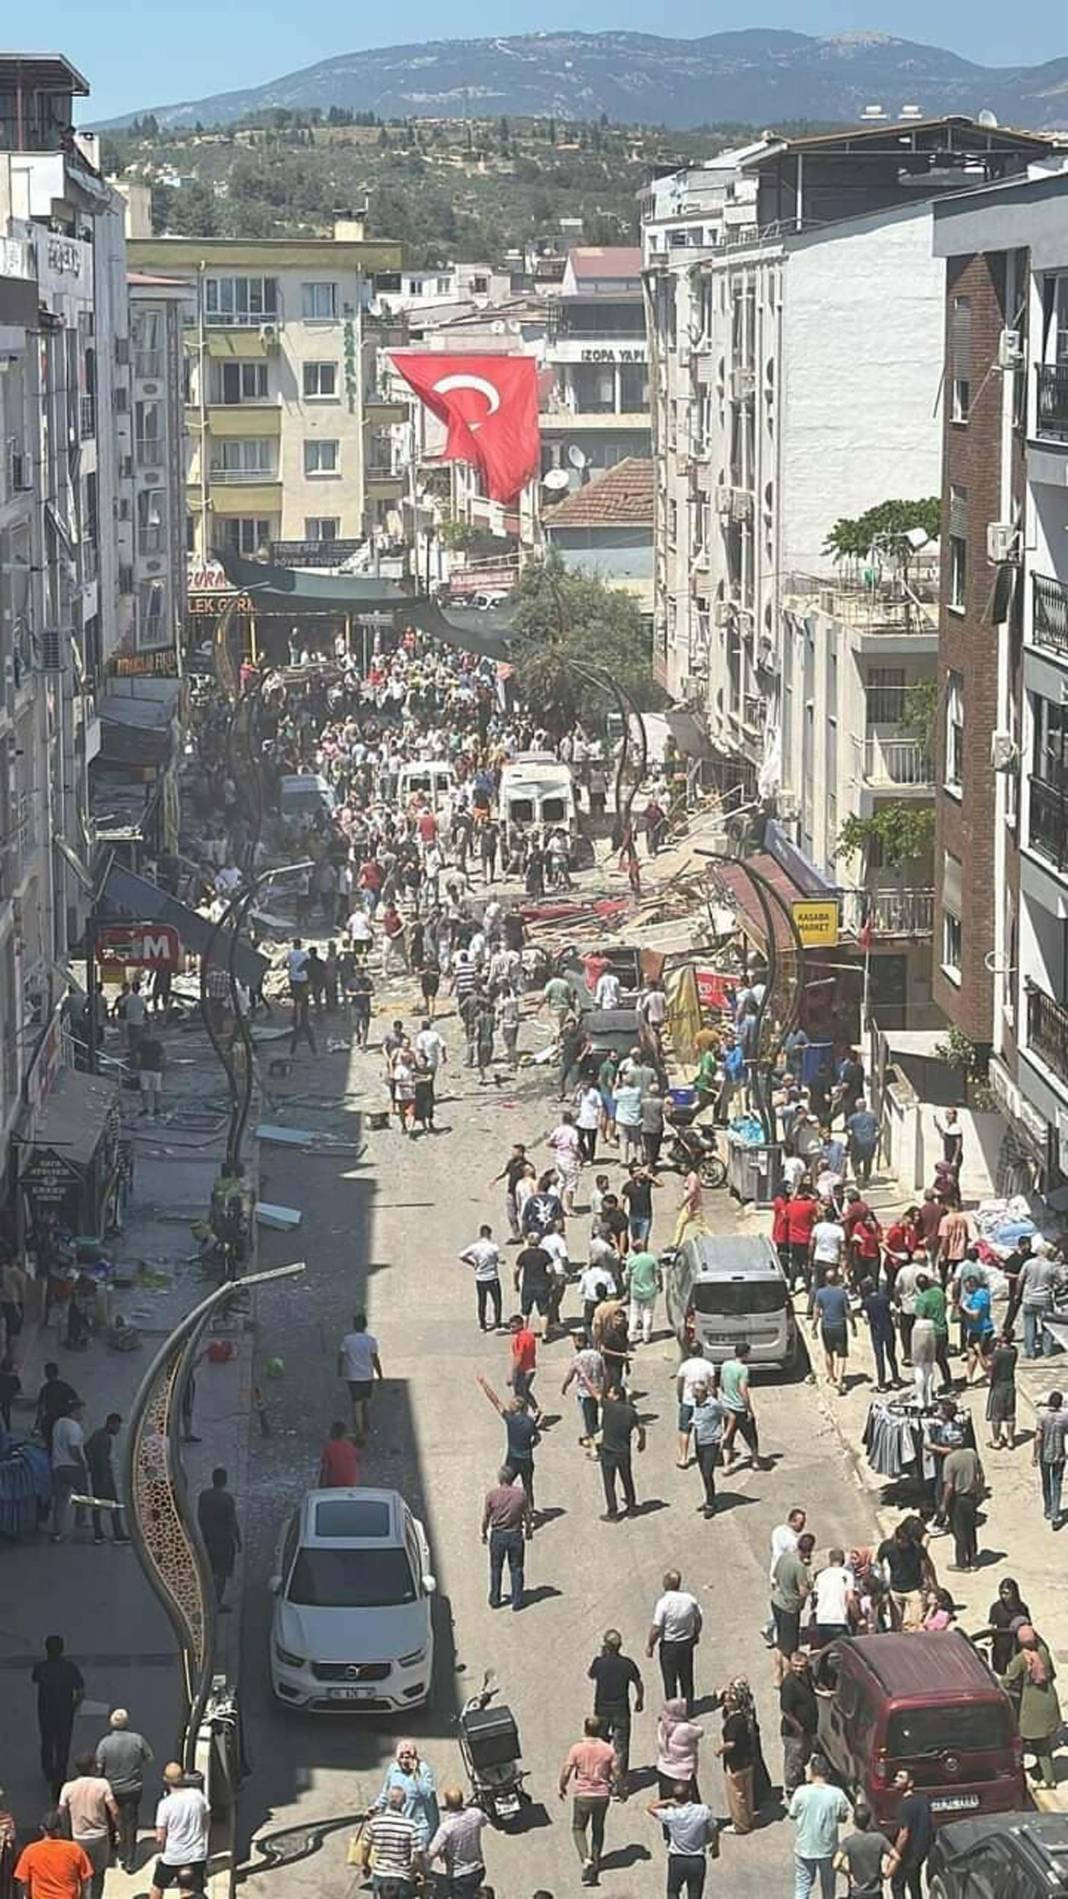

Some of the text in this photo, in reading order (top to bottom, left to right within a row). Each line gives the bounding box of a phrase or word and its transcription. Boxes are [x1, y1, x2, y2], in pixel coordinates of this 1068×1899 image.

[618, 349, 645, 361] YAPI
[798, 913, 829, 921] KASABA
[799, 923, 829, 932] MARKET
